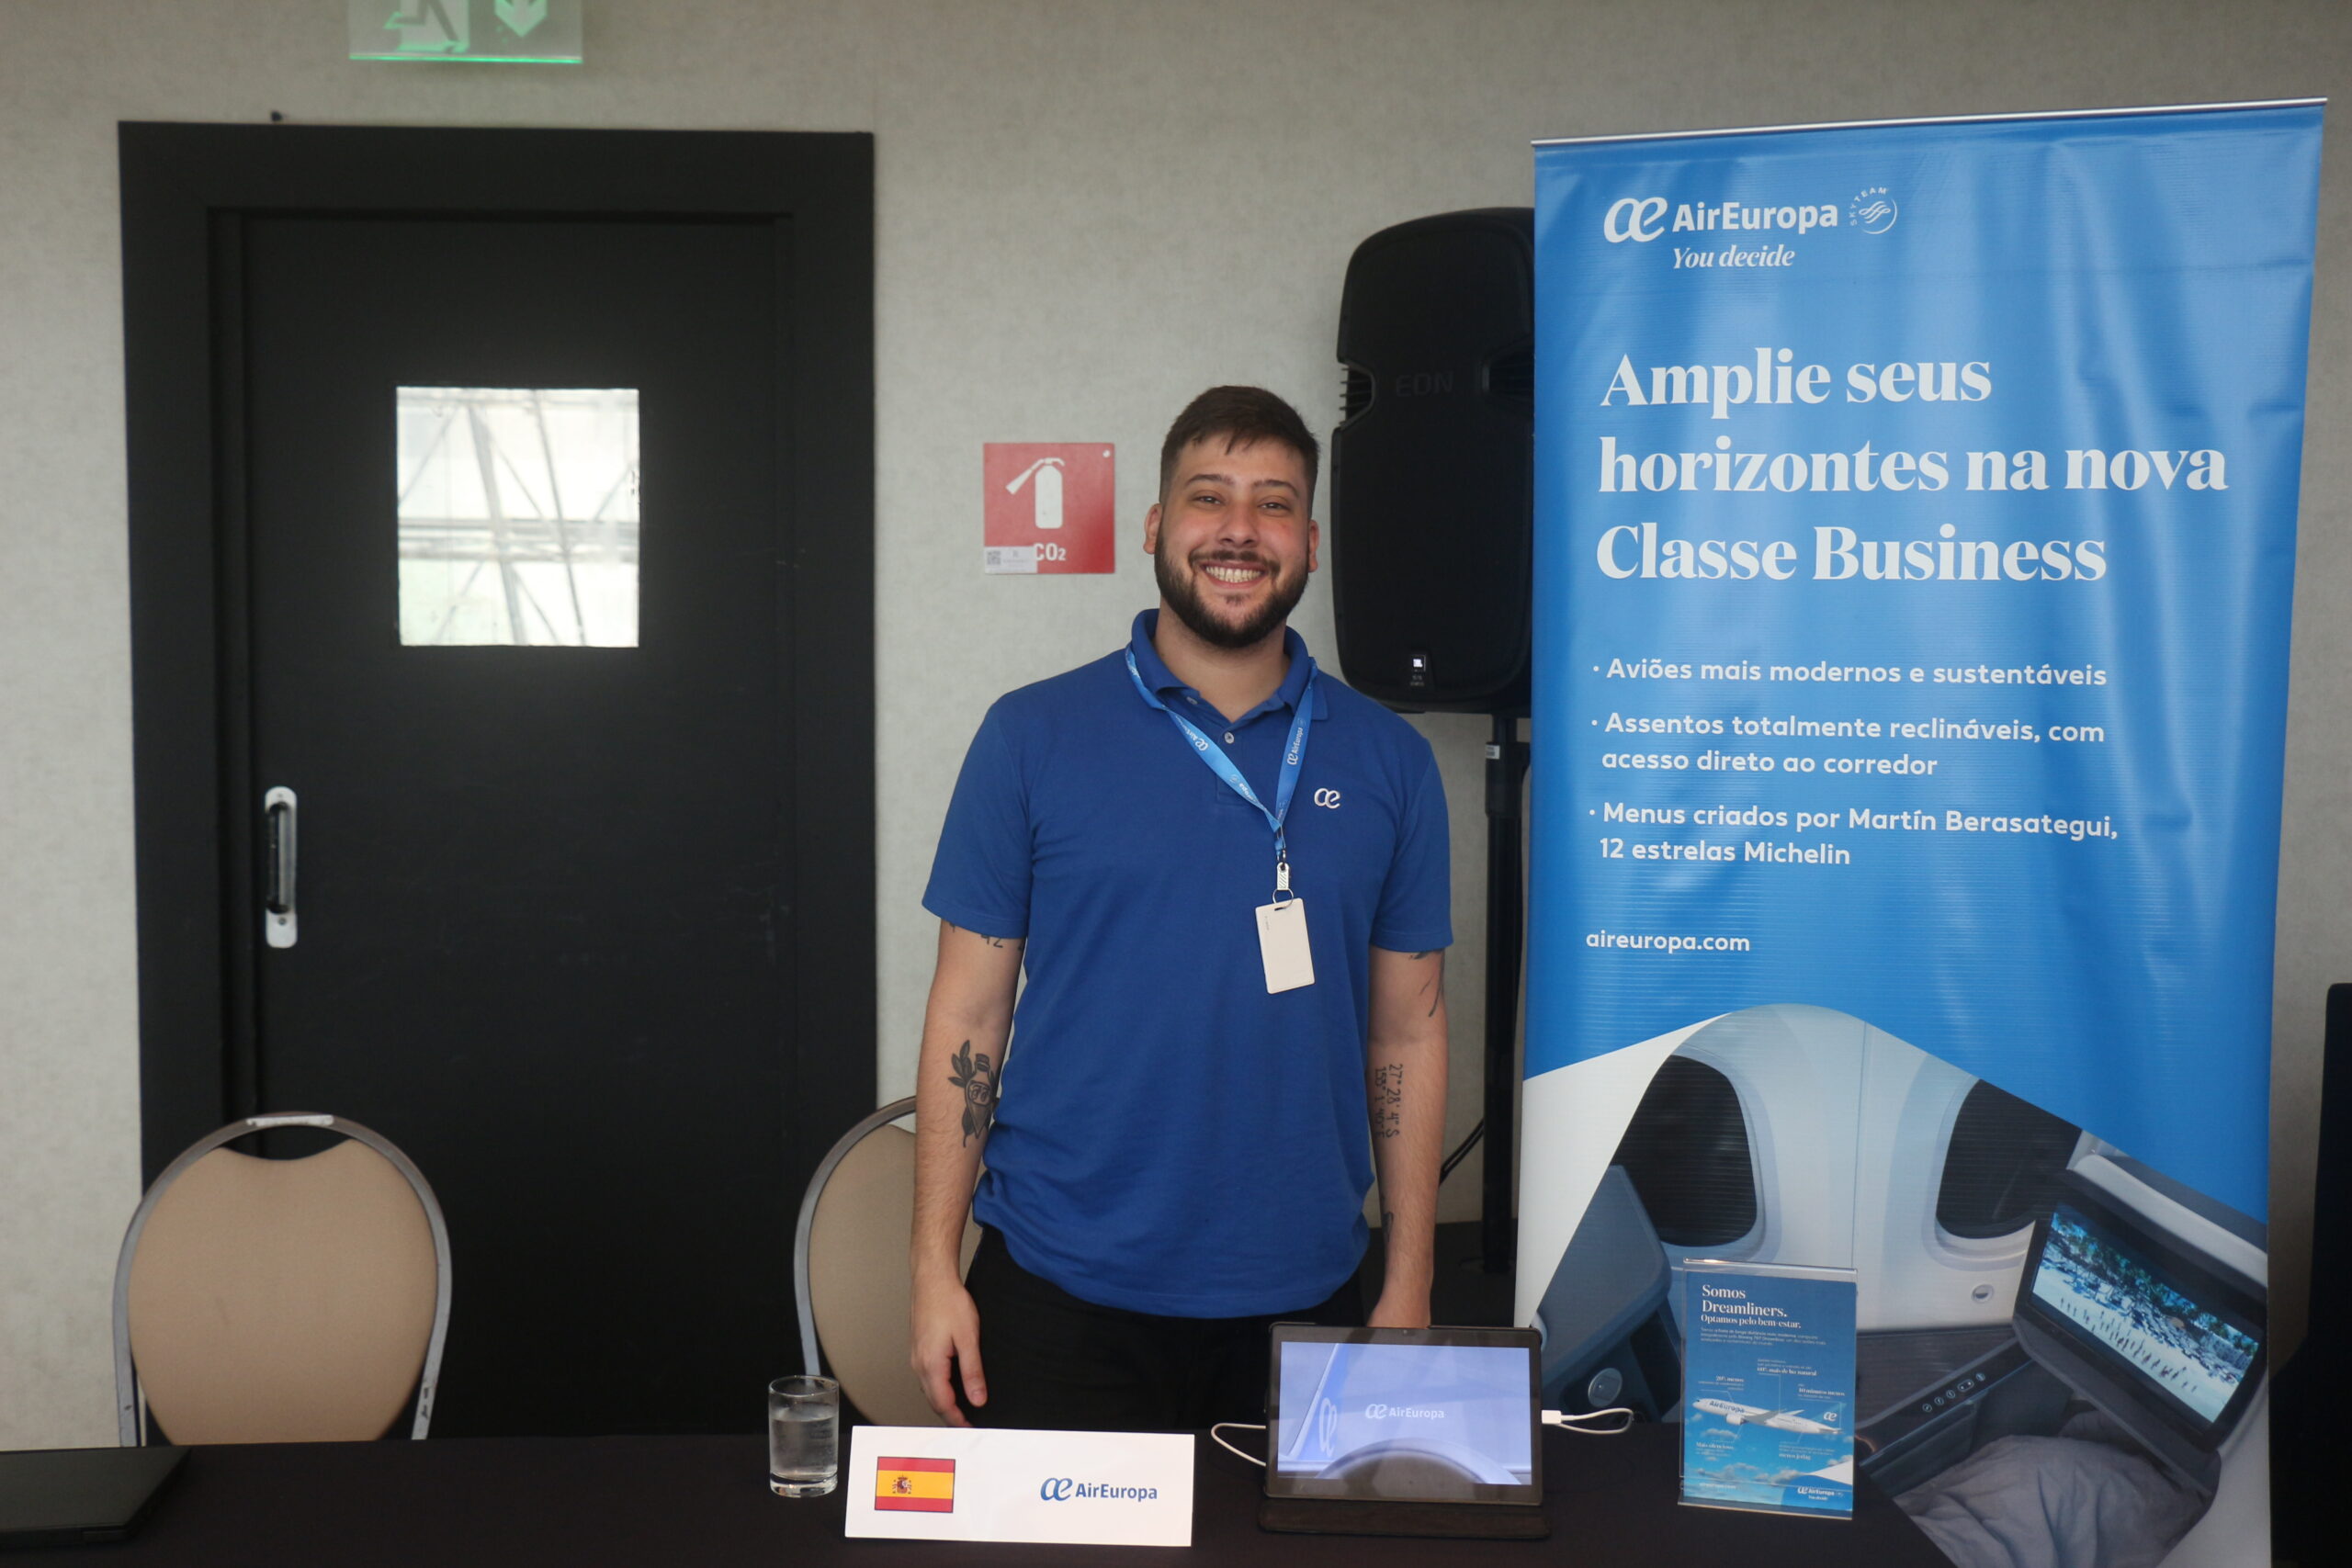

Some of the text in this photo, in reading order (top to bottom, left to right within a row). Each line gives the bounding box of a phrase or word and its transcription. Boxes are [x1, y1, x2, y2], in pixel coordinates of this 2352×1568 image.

[1673, 202, 1838, 234] AirEuropa
[1849, 187, 1887, 226] SKYTEAM
[1674, 244, 1795, 268] You decide
[1600, 347, 1991, 419] Amplie seus
[1600, 435, 2229, 492] horizontes na nova
[1597, 523, 2107, 581] Classe Business
[1607, 659, 2107, 685] Aviões mais modernos e sustentáveis
[1605, 713, 2104, 742] Assentos totalmente reclináveis, com
[1602, 750, 1938, 774] acesso direto ao corredor
[1604, 802, 2117, 840] Menus criados por Martín Berasategui,
[1600, 838, 1849, 864] 12 estrelas Michelin
[1587, 930, 1749, 953] aireuropa.com
[1702, 1284, 1746, 1299] Somos
[1701, 1315, 1738, 1325] Optamos
[1739, 1317, 1757, 1326] pelo
[1702, 1300, 1788, 1317] Dreamliners.
[1389, 1407, 1445, 1420] AirEuropa
[1075, 1483, 1158, 1502] AirEuropa
